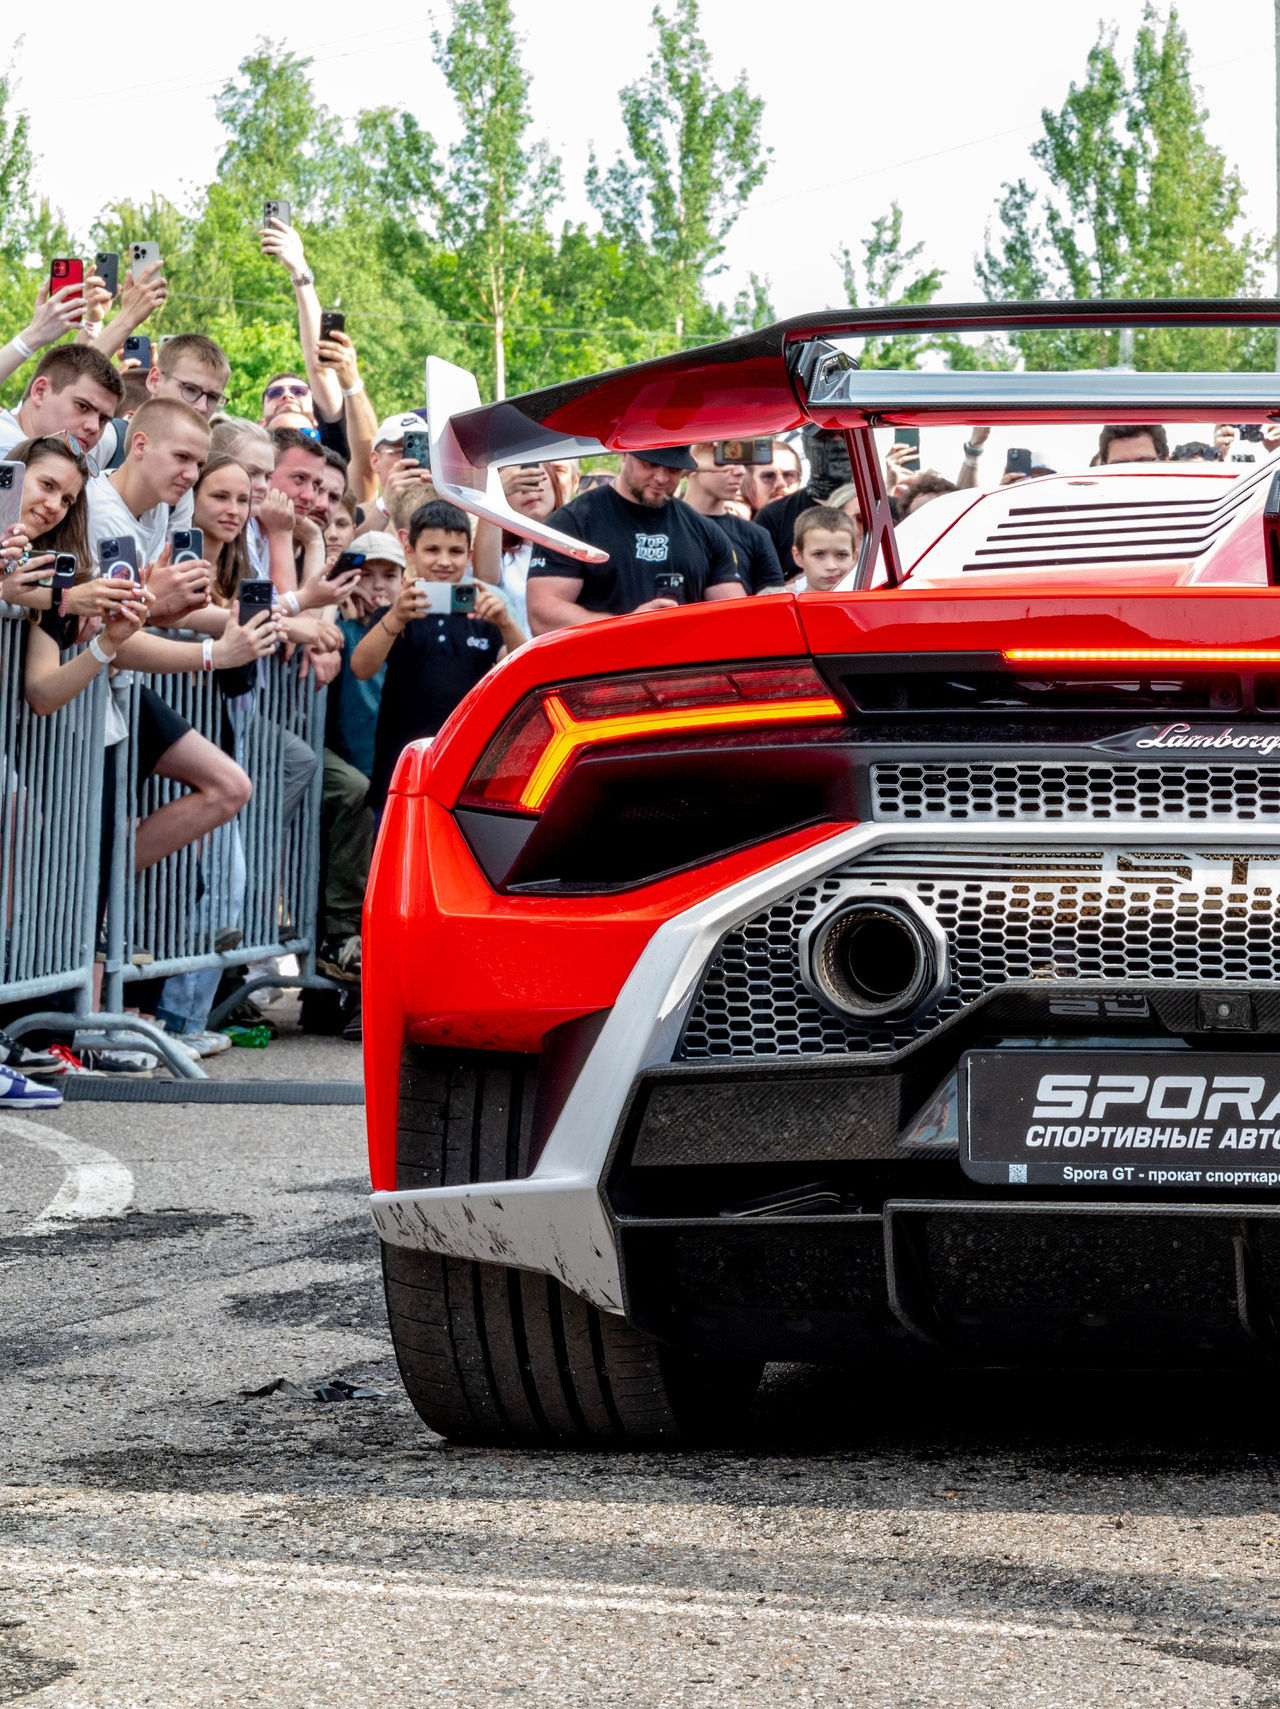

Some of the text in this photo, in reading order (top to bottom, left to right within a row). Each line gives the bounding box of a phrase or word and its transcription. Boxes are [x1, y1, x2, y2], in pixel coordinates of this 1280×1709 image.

[637, 534, 668, 548] TOP
[637, 547, 667, 560] DOG
[1025, 1125, 1213, 1149] СПОРТИВНЫЕ
[1063, 1166, 1108, 1180] Spora
[1112, 1167, 1135, 1180] GT
[1149, 1170, 1202, 1184] прокат
